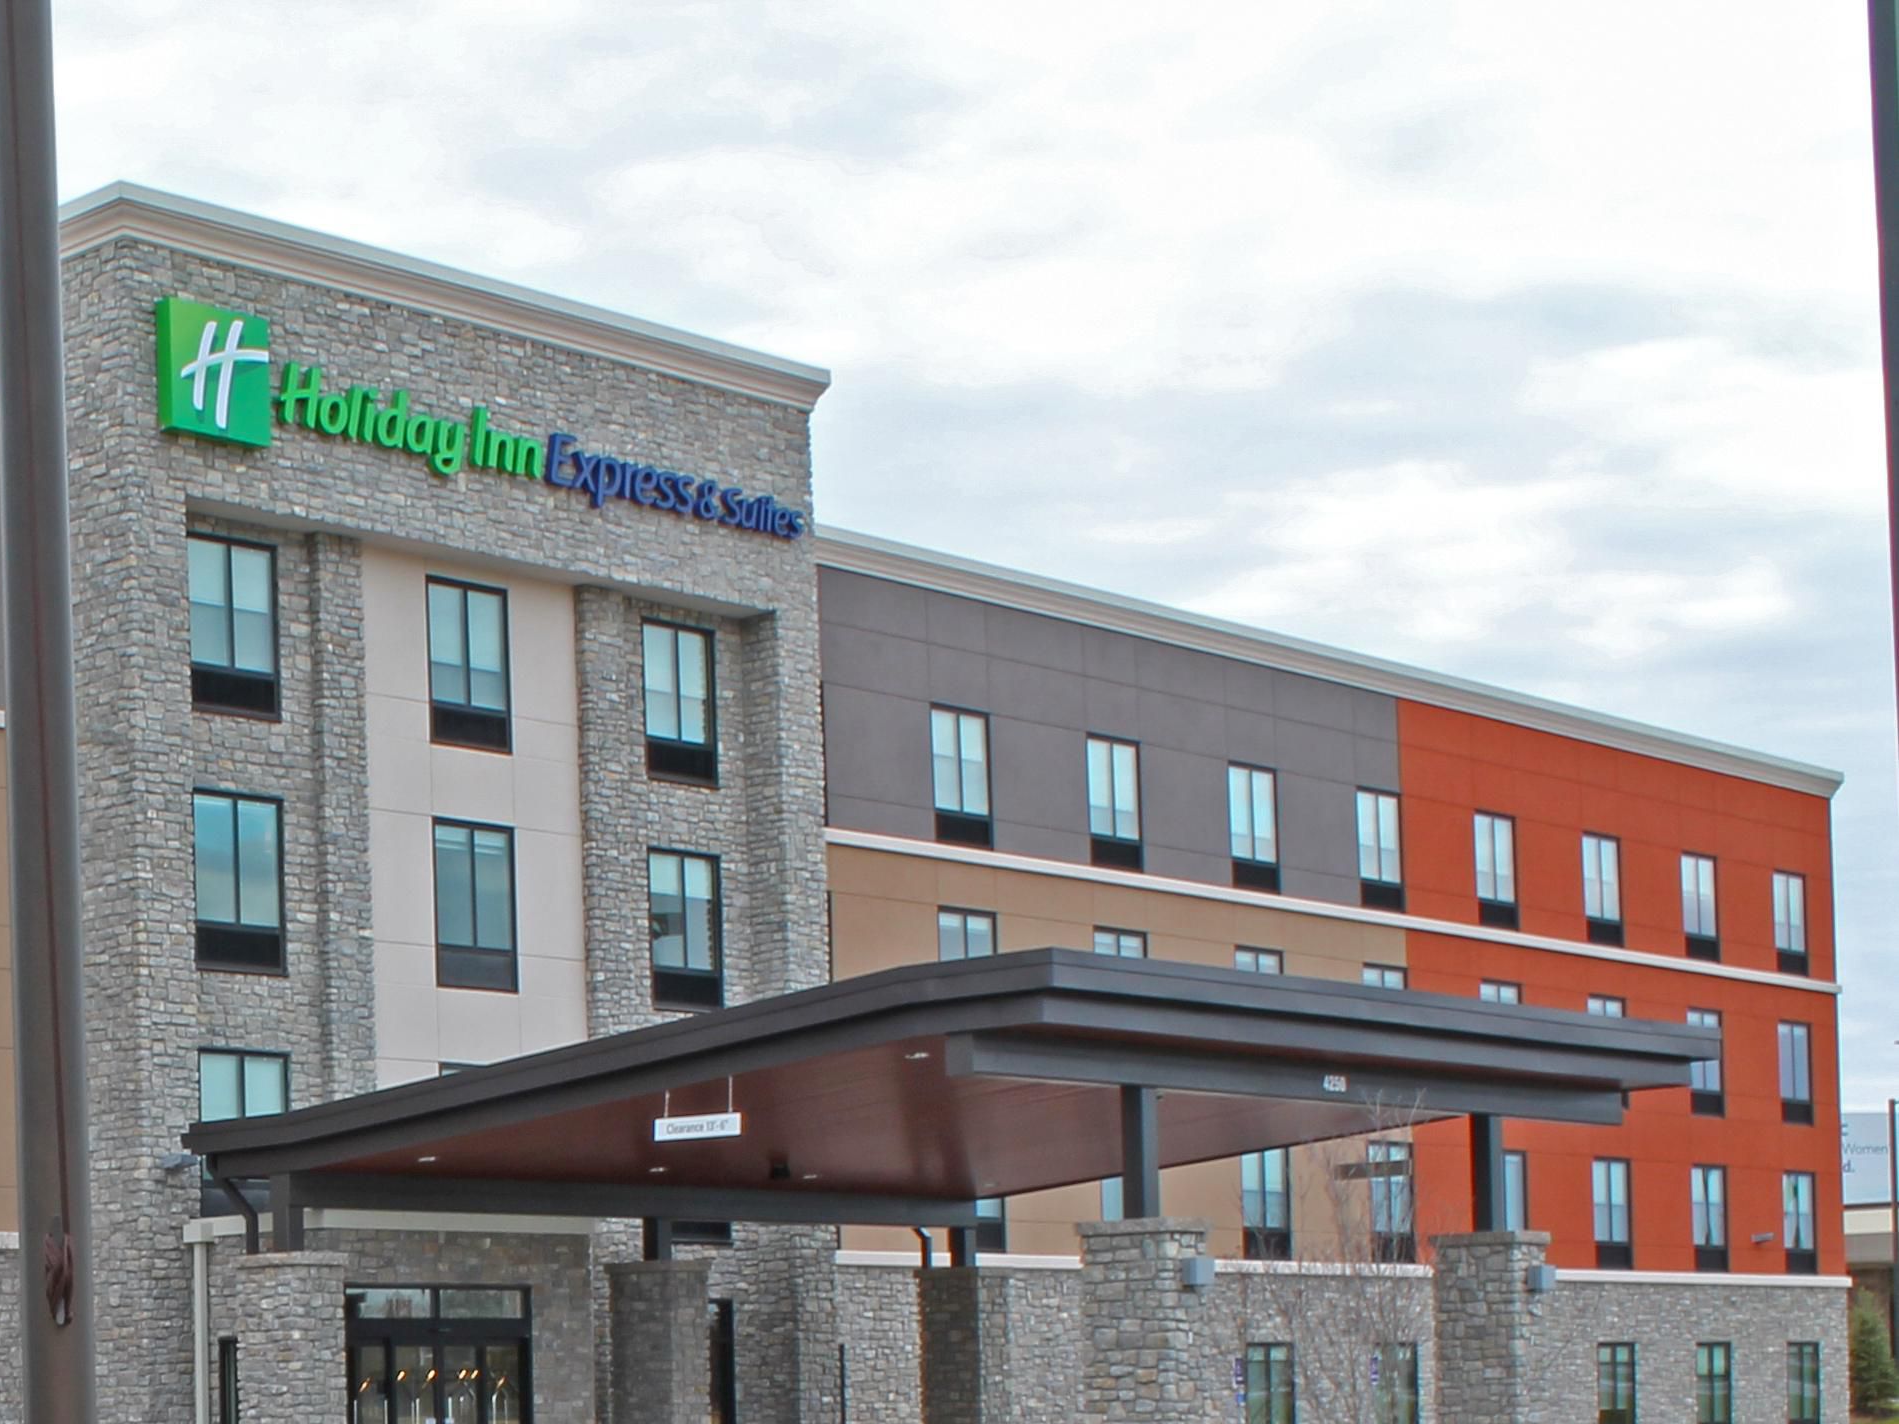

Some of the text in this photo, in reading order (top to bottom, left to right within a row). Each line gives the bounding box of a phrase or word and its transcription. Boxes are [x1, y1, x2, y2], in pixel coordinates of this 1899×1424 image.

[277, 360, 807, 540] Holiday Inn Express & Suites
[666, 1120, 704, 1135] Clearance
